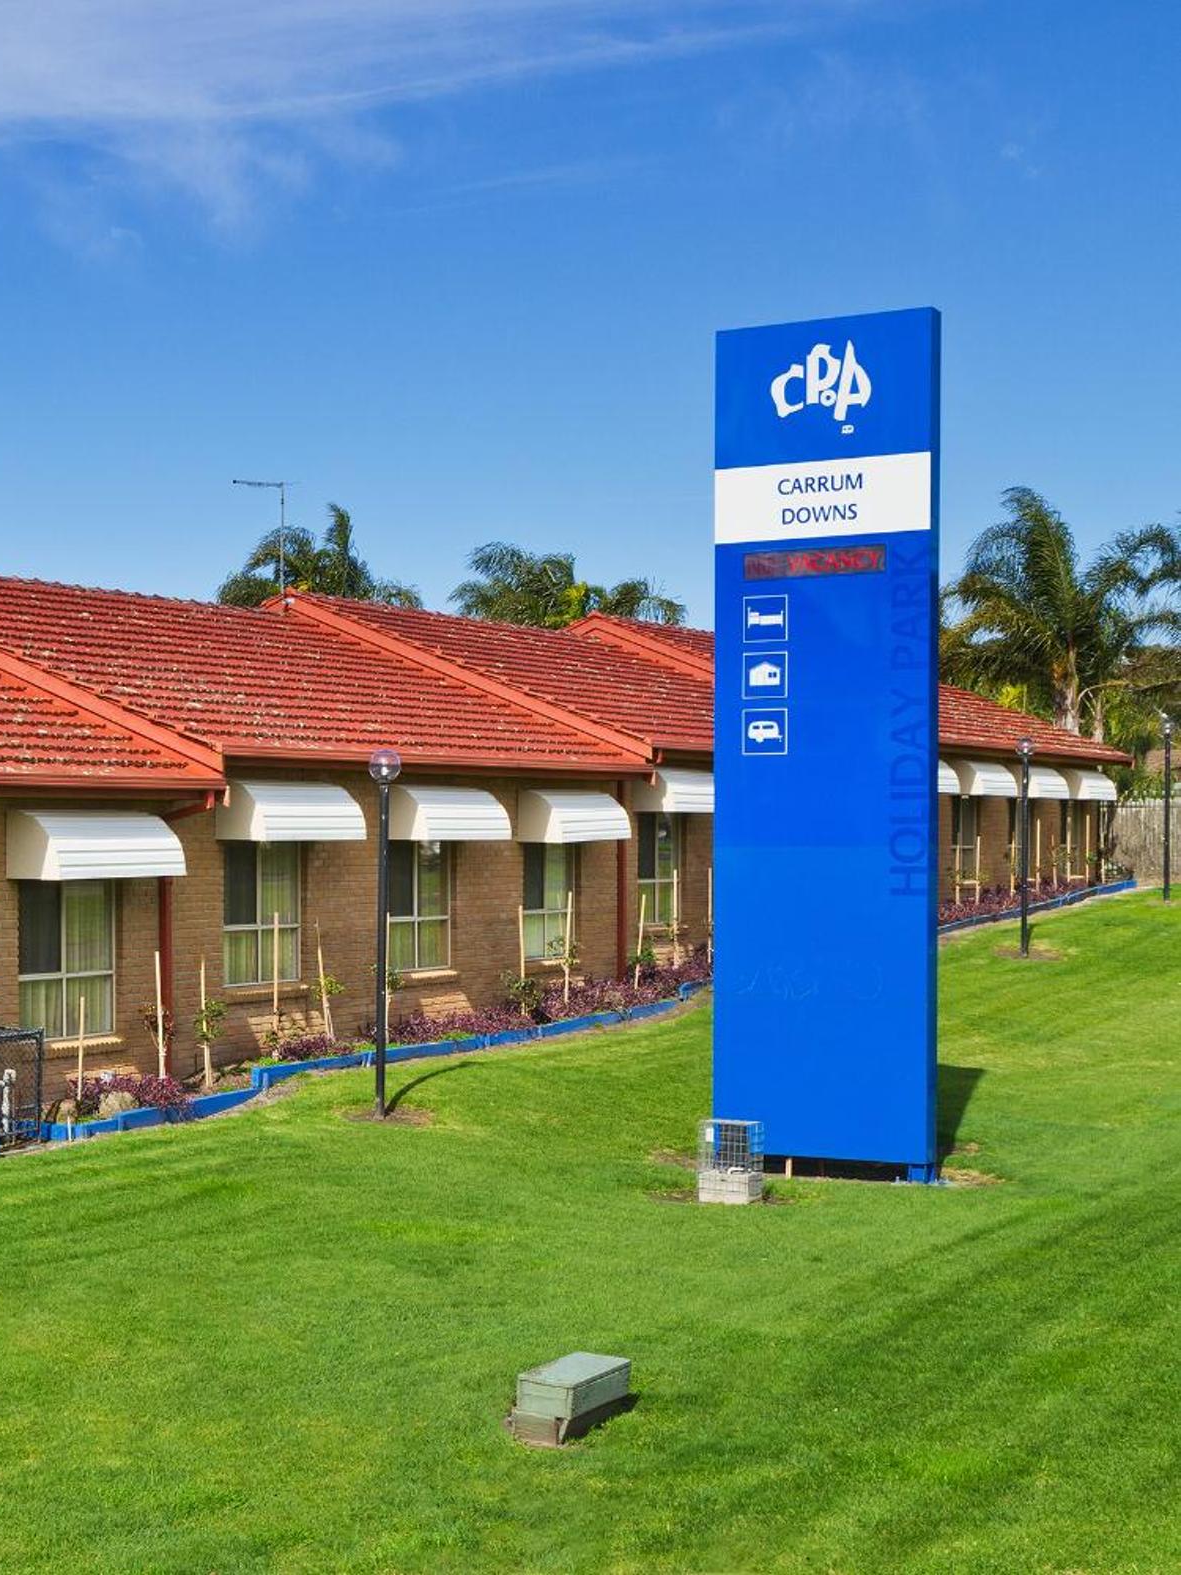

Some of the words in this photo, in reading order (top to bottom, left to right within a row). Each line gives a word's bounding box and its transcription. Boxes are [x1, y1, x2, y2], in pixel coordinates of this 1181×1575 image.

[777, 472, 864, 496] CARRUM
[781, 503, 858, 526] DOWNS
[786, 549, 881, 574] VACANCY
[890, 543, 930, 671] PARK
[889, 687, 928, 898] HOLIDAY
